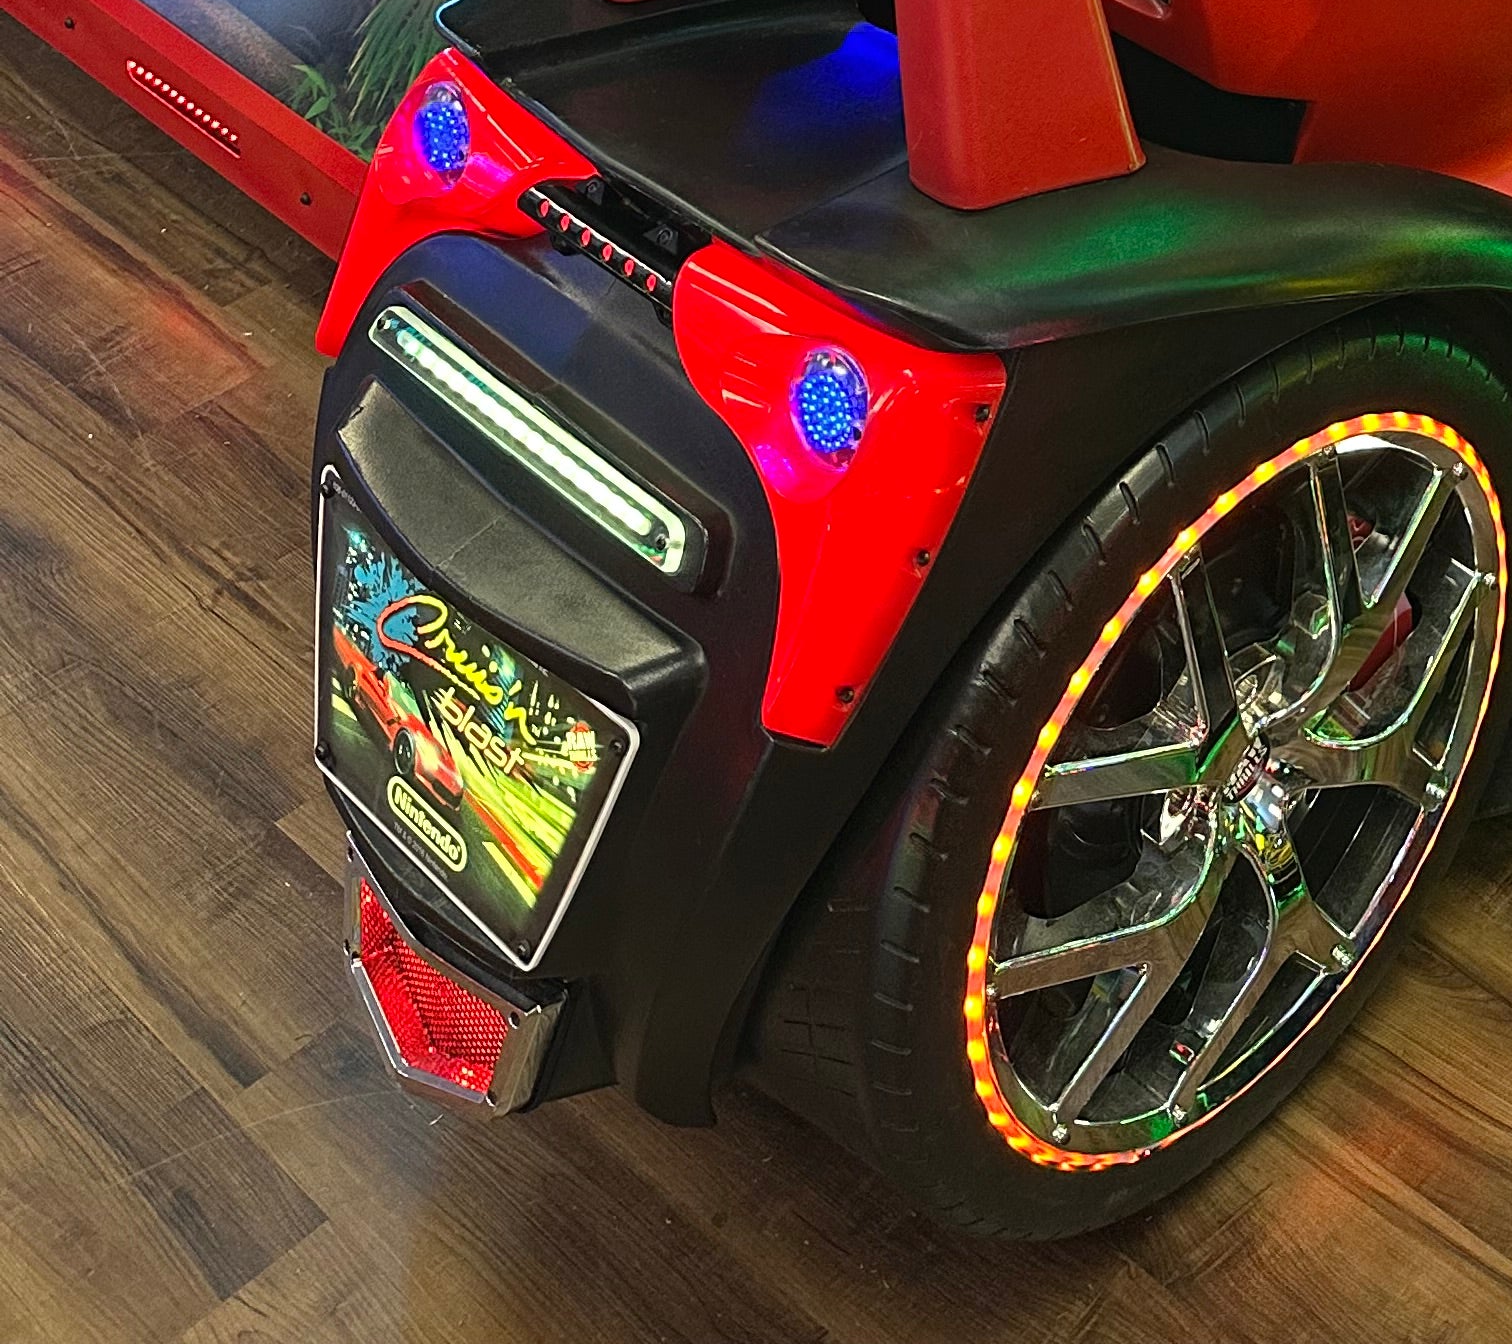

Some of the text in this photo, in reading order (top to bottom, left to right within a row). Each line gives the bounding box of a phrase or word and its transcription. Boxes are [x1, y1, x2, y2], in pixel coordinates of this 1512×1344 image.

[376, 594, 538, 745] Cruis'n
[436, 683, 529, 775] blast
[565, 730, 596, 751] RAW
[393, 790, 462, 863] Nintendo
